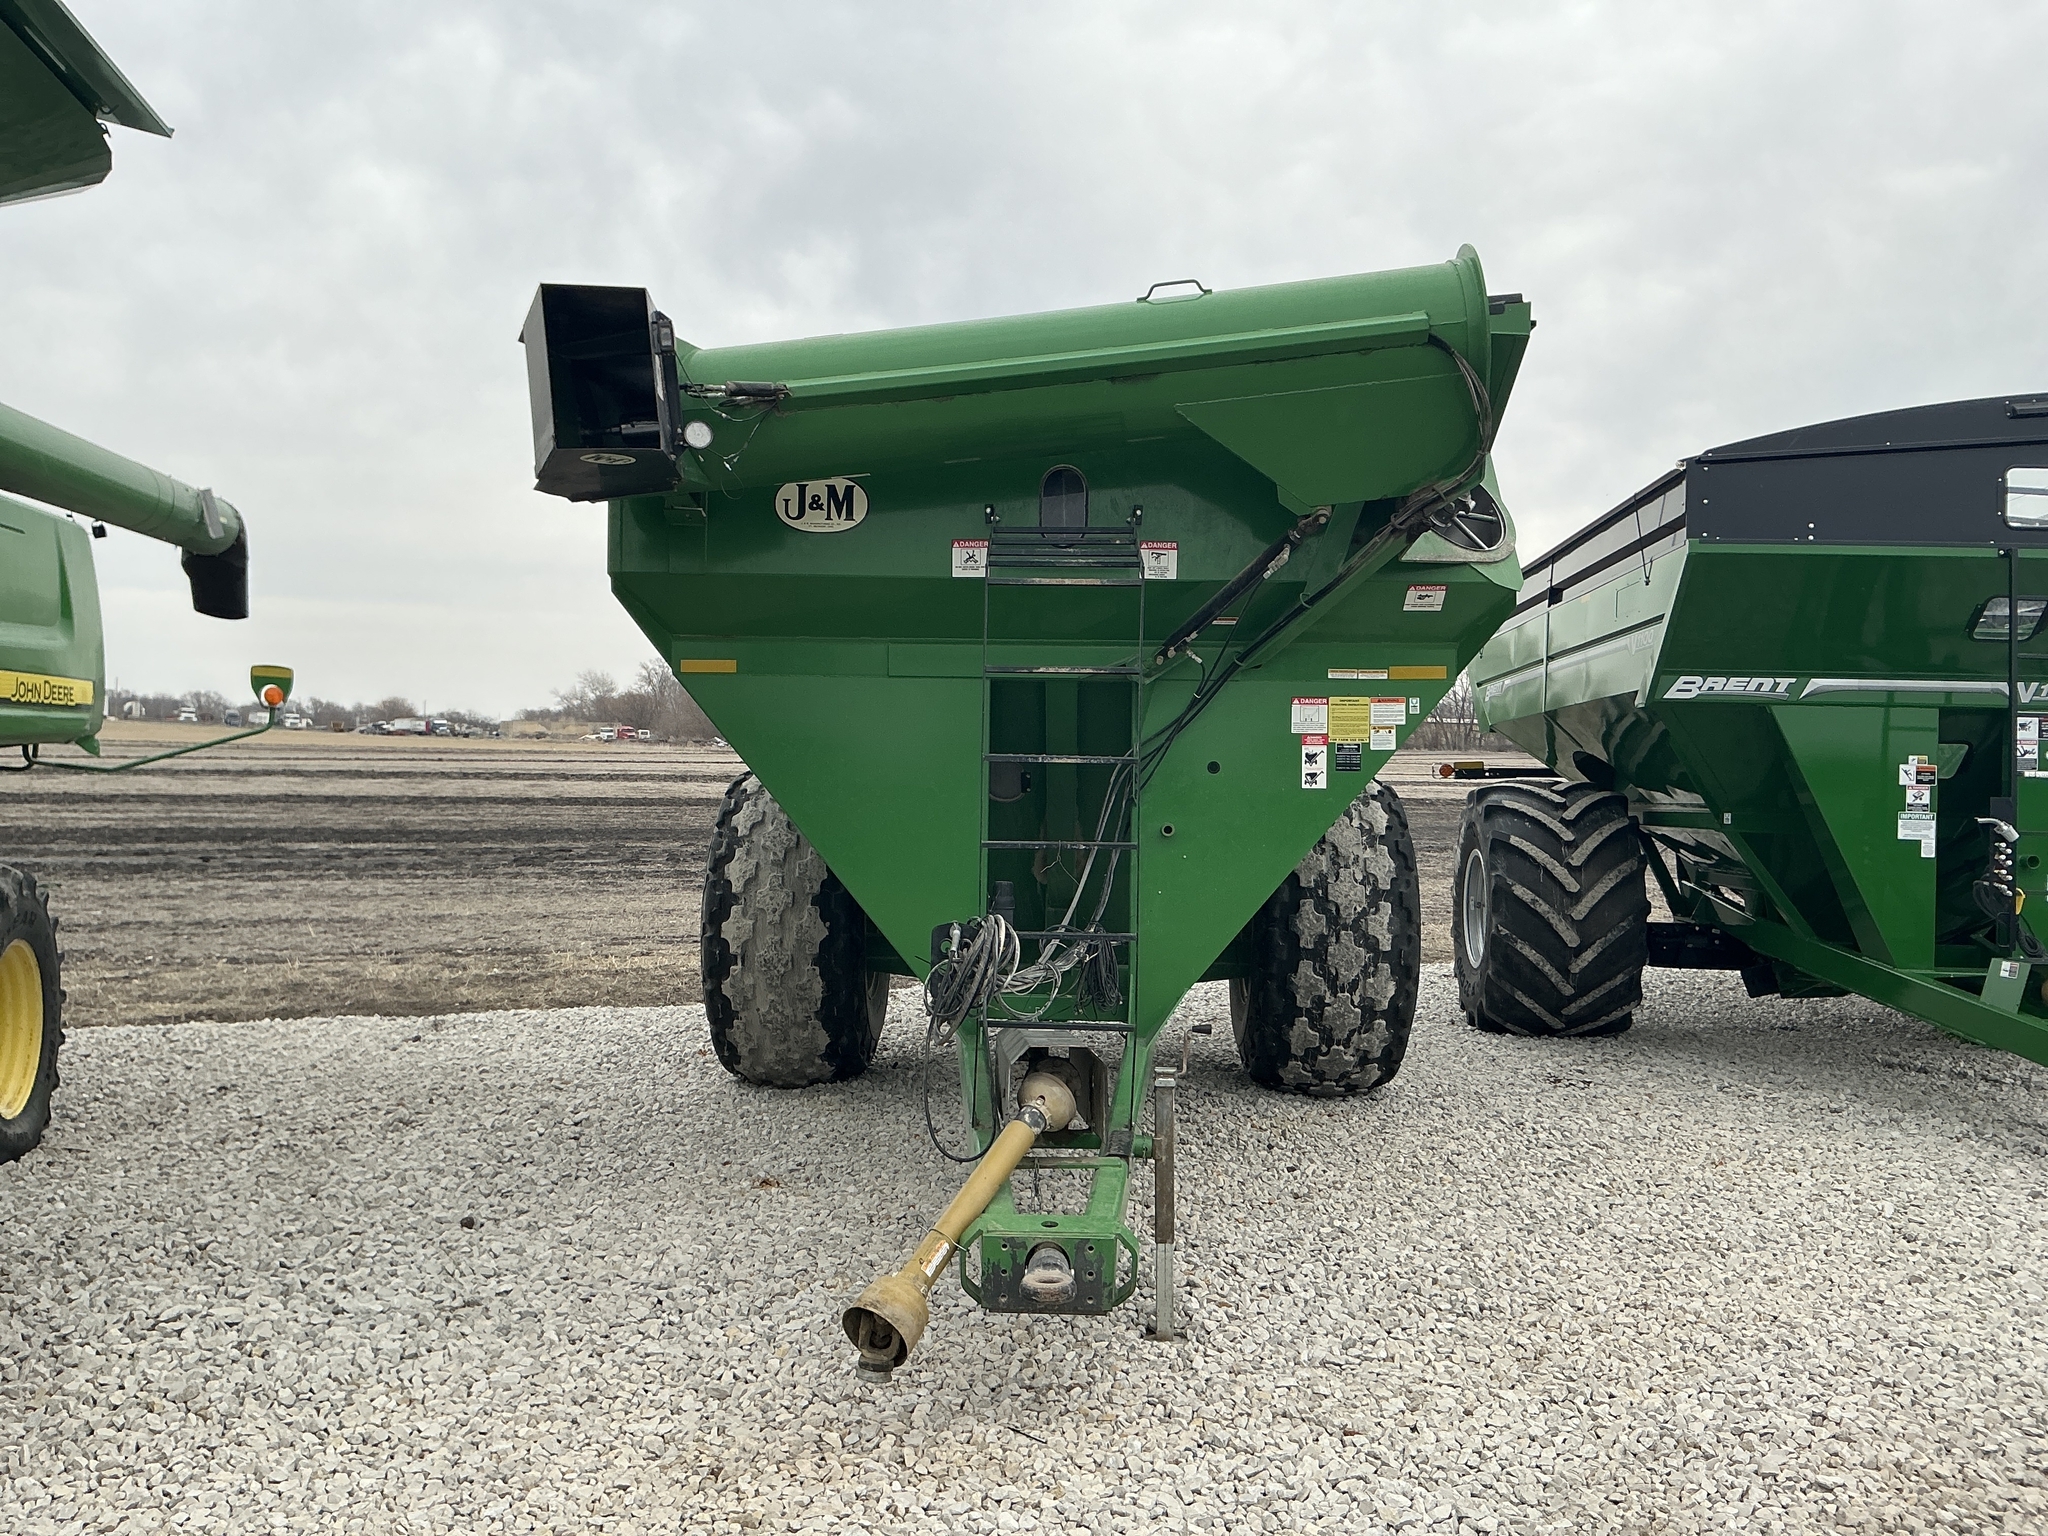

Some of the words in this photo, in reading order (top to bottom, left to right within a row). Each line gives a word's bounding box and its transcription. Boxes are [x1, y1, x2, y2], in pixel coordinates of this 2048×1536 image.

[782, 483, 857, 521] J&M
[11, 676, 42, 700] JOHN
[43, 680, 75, 702] DEERE
[1662, 675, 1797, 699] BRENT
